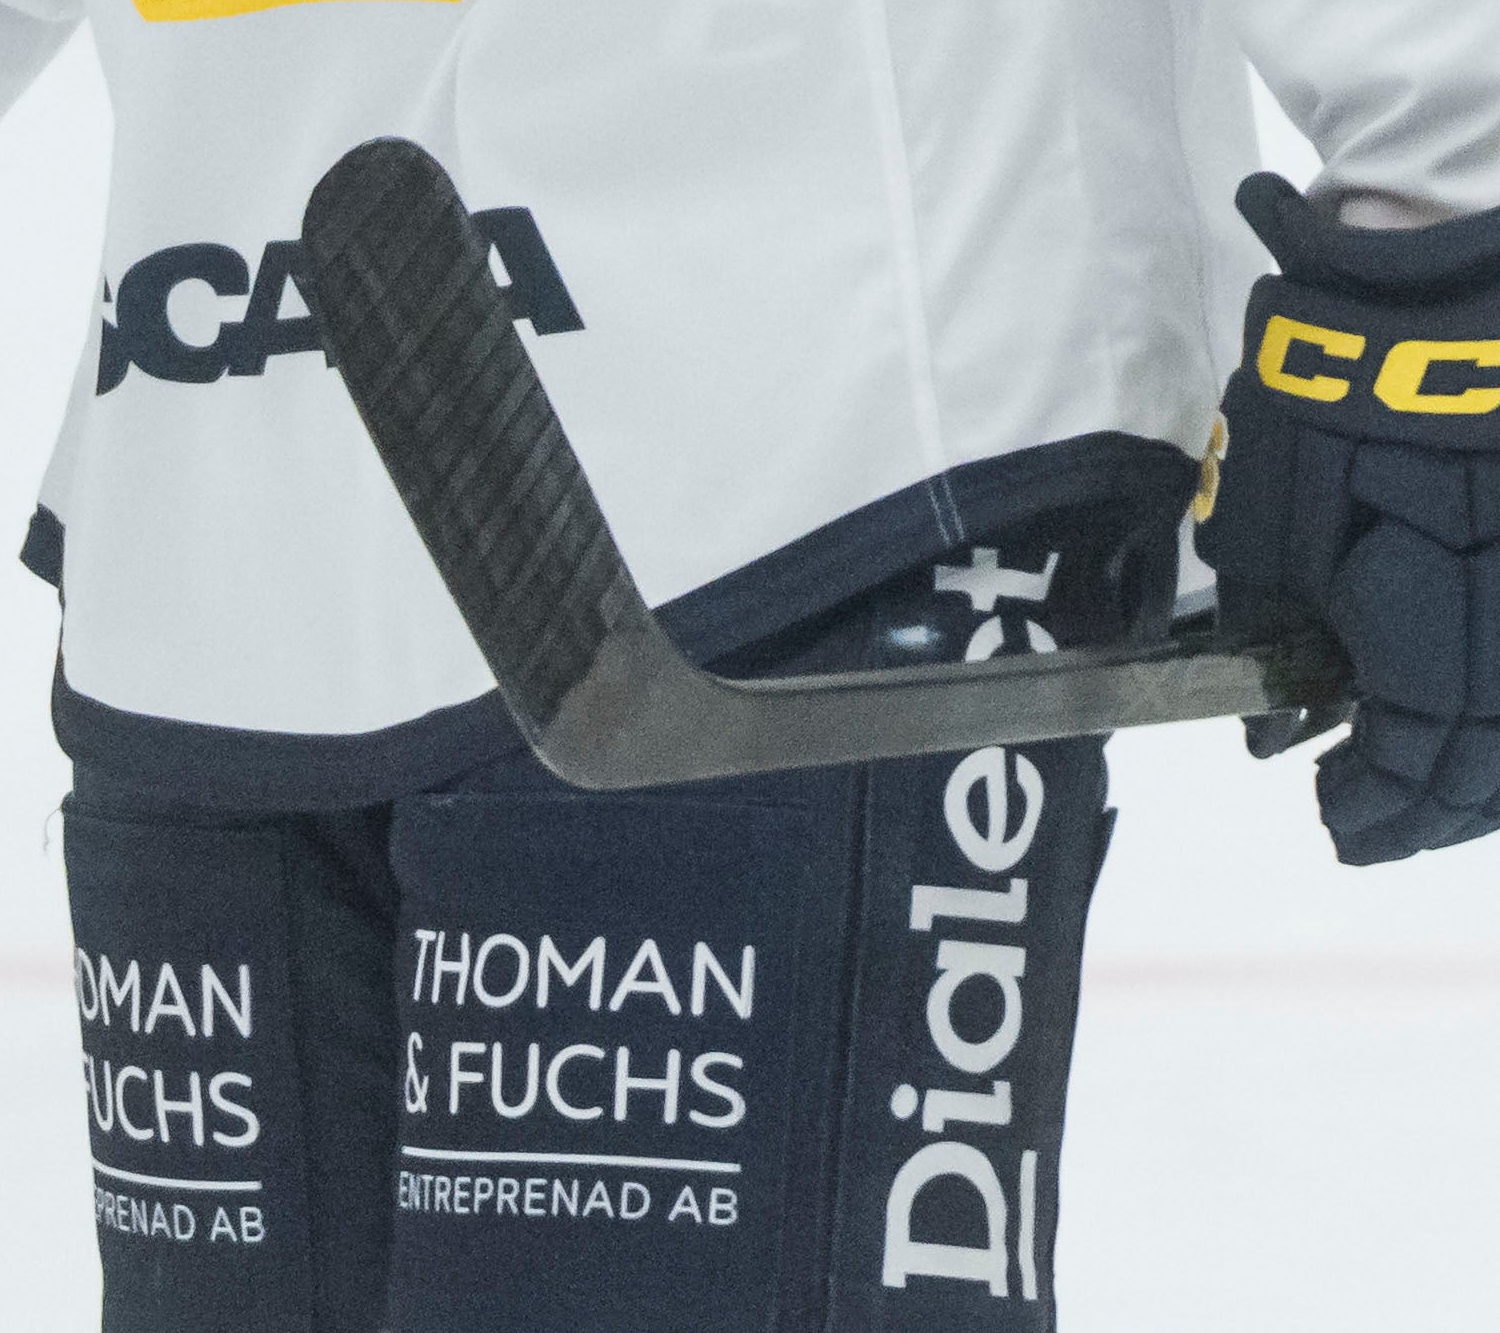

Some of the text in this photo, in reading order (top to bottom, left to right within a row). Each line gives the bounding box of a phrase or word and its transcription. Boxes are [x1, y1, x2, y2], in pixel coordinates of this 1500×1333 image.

[411, 928, 756, 1020] THOMAN
[82, 1050, 261, 1149] UCHS
[404, 1031, 748, 1129] & FUCHS
[210, 1205, 267, 1244] AB
[399, 1169, 740, 1227] ENTREPRENAD AB
